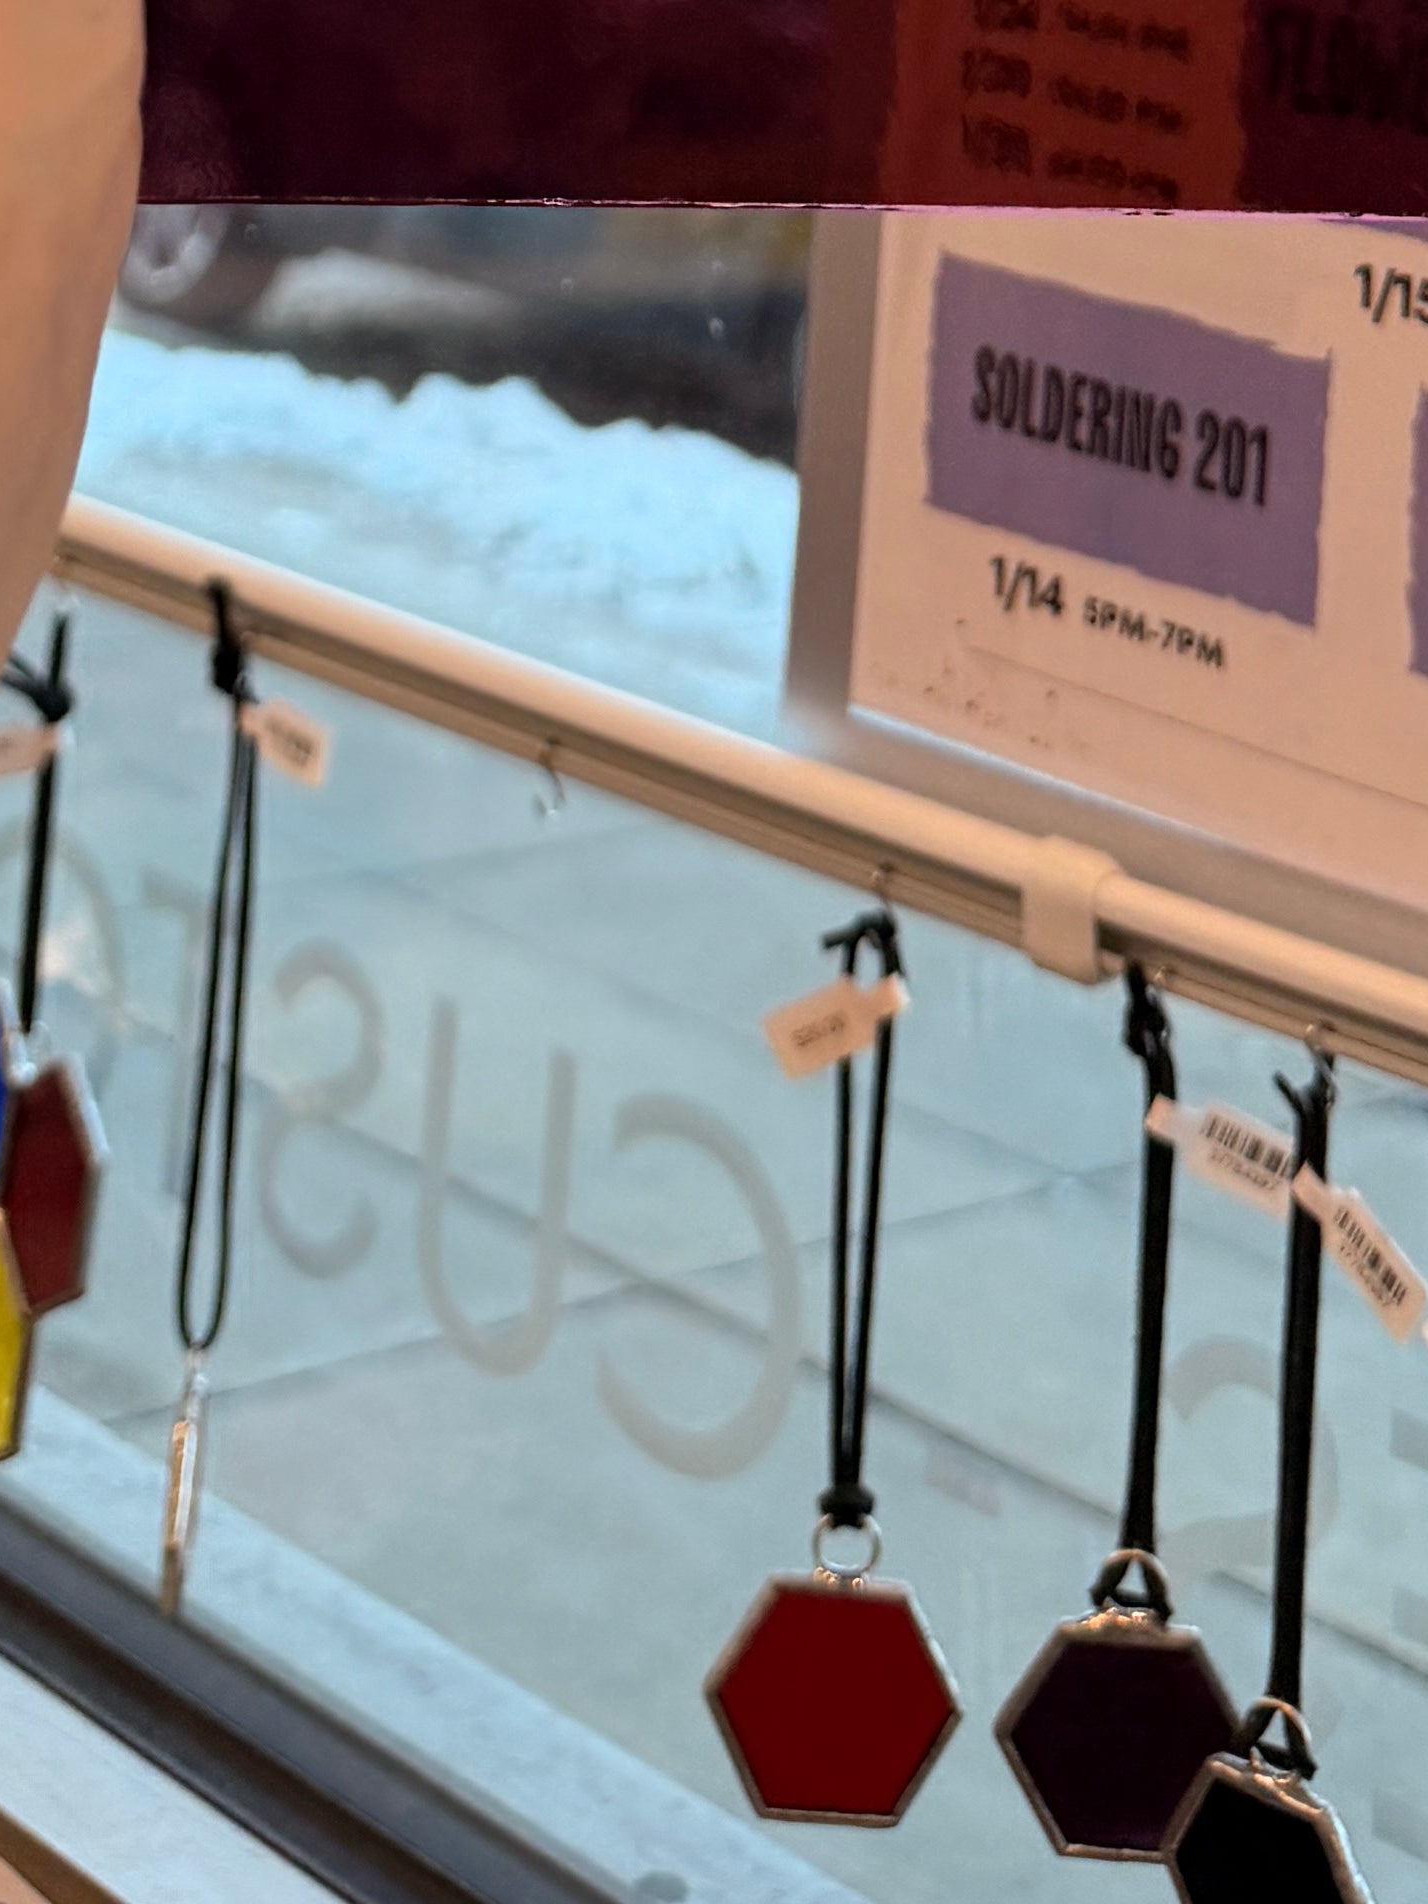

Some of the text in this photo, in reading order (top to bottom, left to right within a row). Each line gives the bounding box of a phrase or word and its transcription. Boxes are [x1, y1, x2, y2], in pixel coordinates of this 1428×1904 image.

[970, 343, 1270, 508] SOLDERING 201
[988, 554, 1228, 669] 1/14 5PM-7PM
